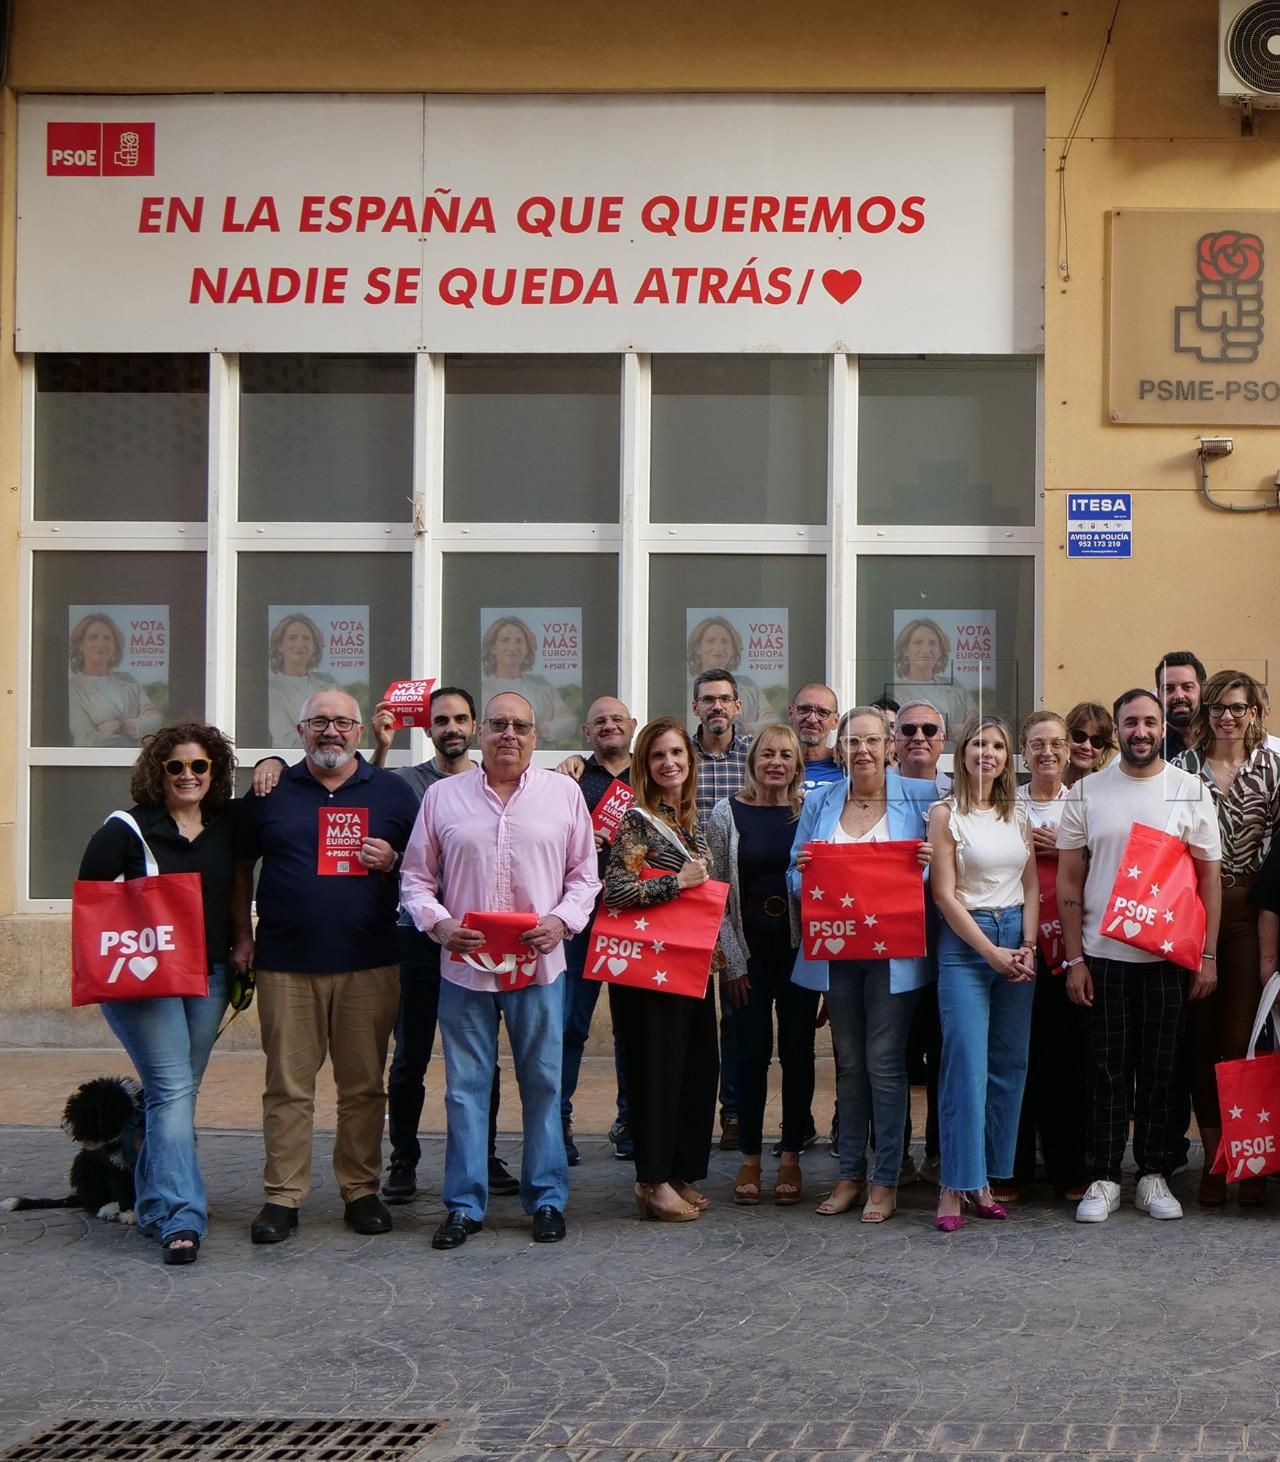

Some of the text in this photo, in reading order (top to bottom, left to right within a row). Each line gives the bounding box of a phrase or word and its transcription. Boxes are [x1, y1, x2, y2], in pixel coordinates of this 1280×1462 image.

[52, 150, 97, 166] PSOE
[138, 188, 926, 237] EN LA ESPAÑA QUE QUEREMOS
[189, 267, 348, 305] NADIE
[364, 267, 421, 305] SE
[438, 267, 618, 309] QUEDA
[1072, 499, 1127, 512] ITESA
[1070, 533, 1092, 541] AVISO
[1101, 532, 1129, 541] POLICÍA
[131, 621, 164, 630] VOTA
[330, 621, 364, 631] VOTA
[543, 623, 577, 633] VOTA
[749, 624, 784, 633] VOTA
[957, 625, 991, 636] VOTA
[131, 632, 164, 646] MÁS
[331, 631, 364, 646] MÁS
[543, 633, 577, 648] MÁS
[749, 634, 784, 649] MÁS
[957, 636, 991, 651] MÁS
[542, 649, 577, 657] EUROPA
[956, 651, 991, 659] EUROPA
[398, 681, 427, 689] VOTA
[603, 805, 622, 819] EURO
[607, 796, 628, 816] MÁ
[326, 813, 361, 824] VOTA
[326, 824, 361, 838] MÁS
[1113, 896, 1158, 926] PSOE
[809, 920, 856, 937] PSOE
[1040, 919, 1062, 939] PS
[100, 925, 176, 956] PSOE
[595, 935, 644, 960] PSOE
[1231, 1135, 1276, 1158] PSOE
